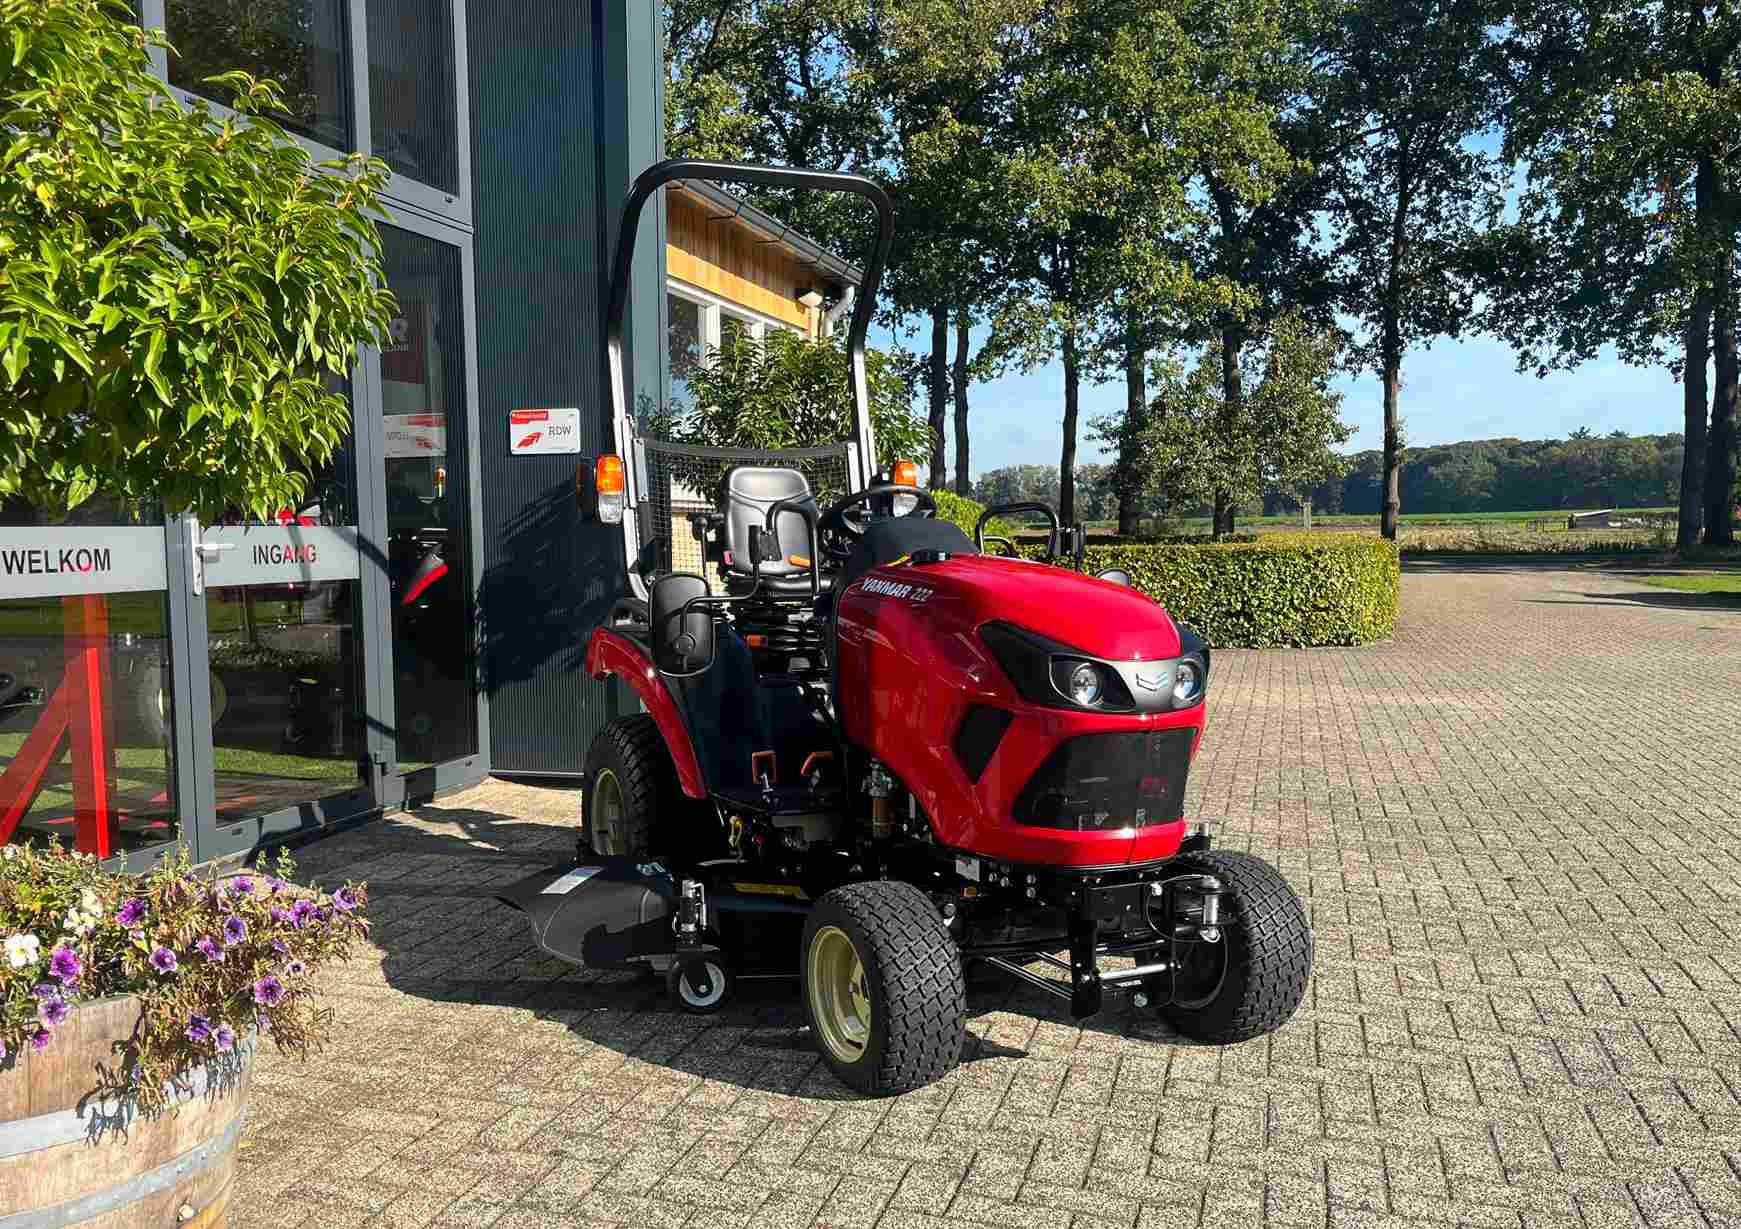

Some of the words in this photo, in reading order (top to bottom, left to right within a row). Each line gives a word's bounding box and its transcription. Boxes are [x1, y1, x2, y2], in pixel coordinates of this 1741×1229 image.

[548, 425, 571, 436] RDW
[1, 548, 111, 575] WELKOM
[252, 543, 317, 565] INGANG
[862, 577, 912, 598] YANMAR
